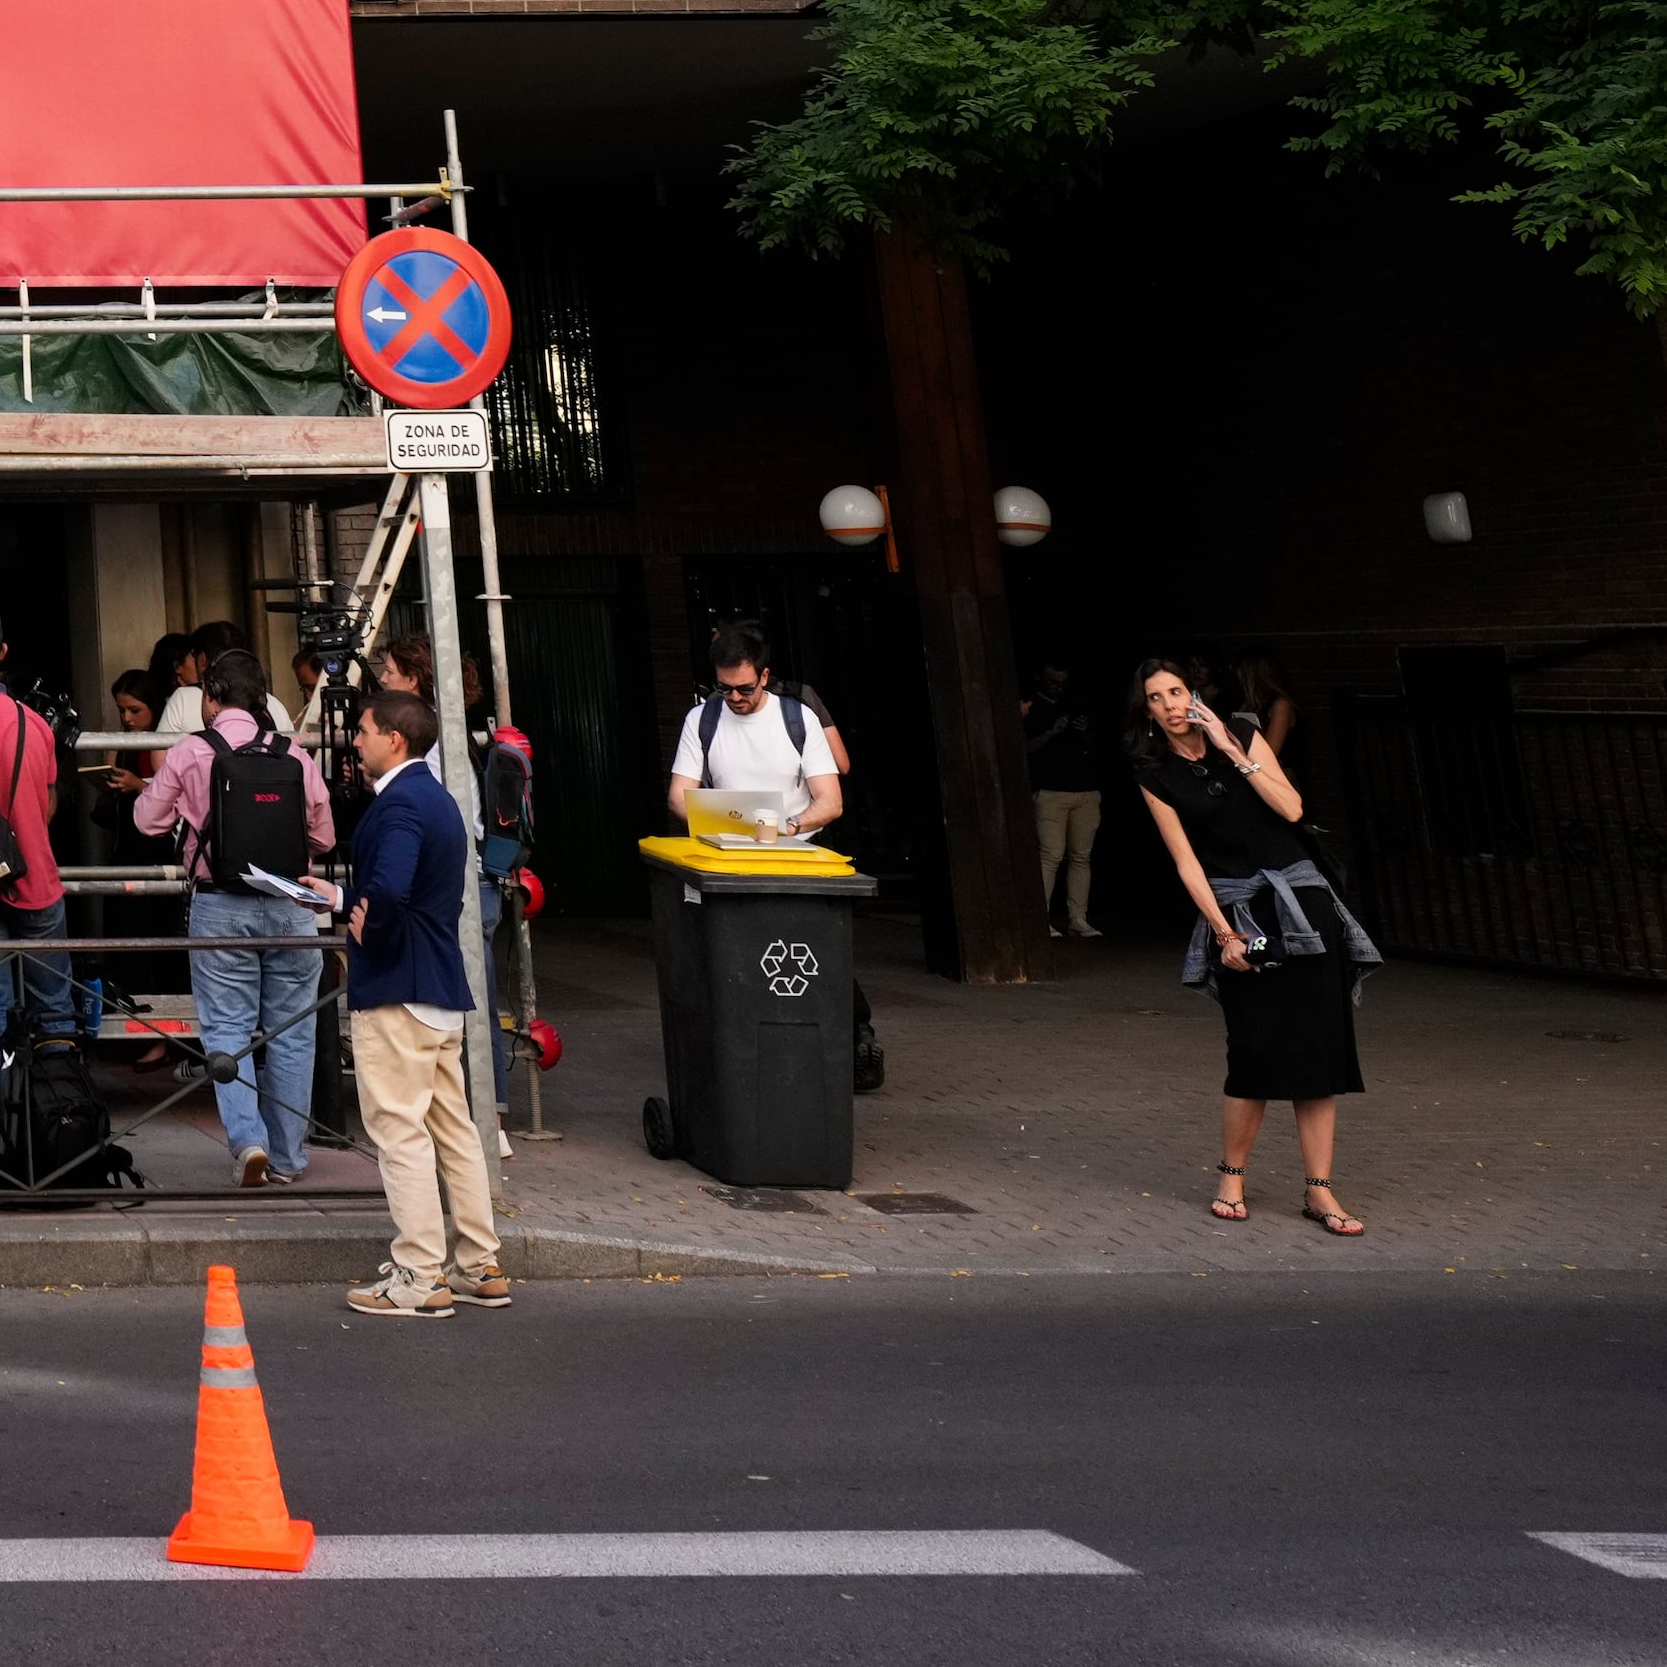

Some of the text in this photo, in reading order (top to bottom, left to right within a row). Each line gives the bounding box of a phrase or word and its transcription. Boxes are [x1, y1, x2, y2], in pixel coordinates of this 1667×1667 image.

[405, 424, 470, 438] ZONA DE
[398, 443, 480, 457] SEGURIDAD
